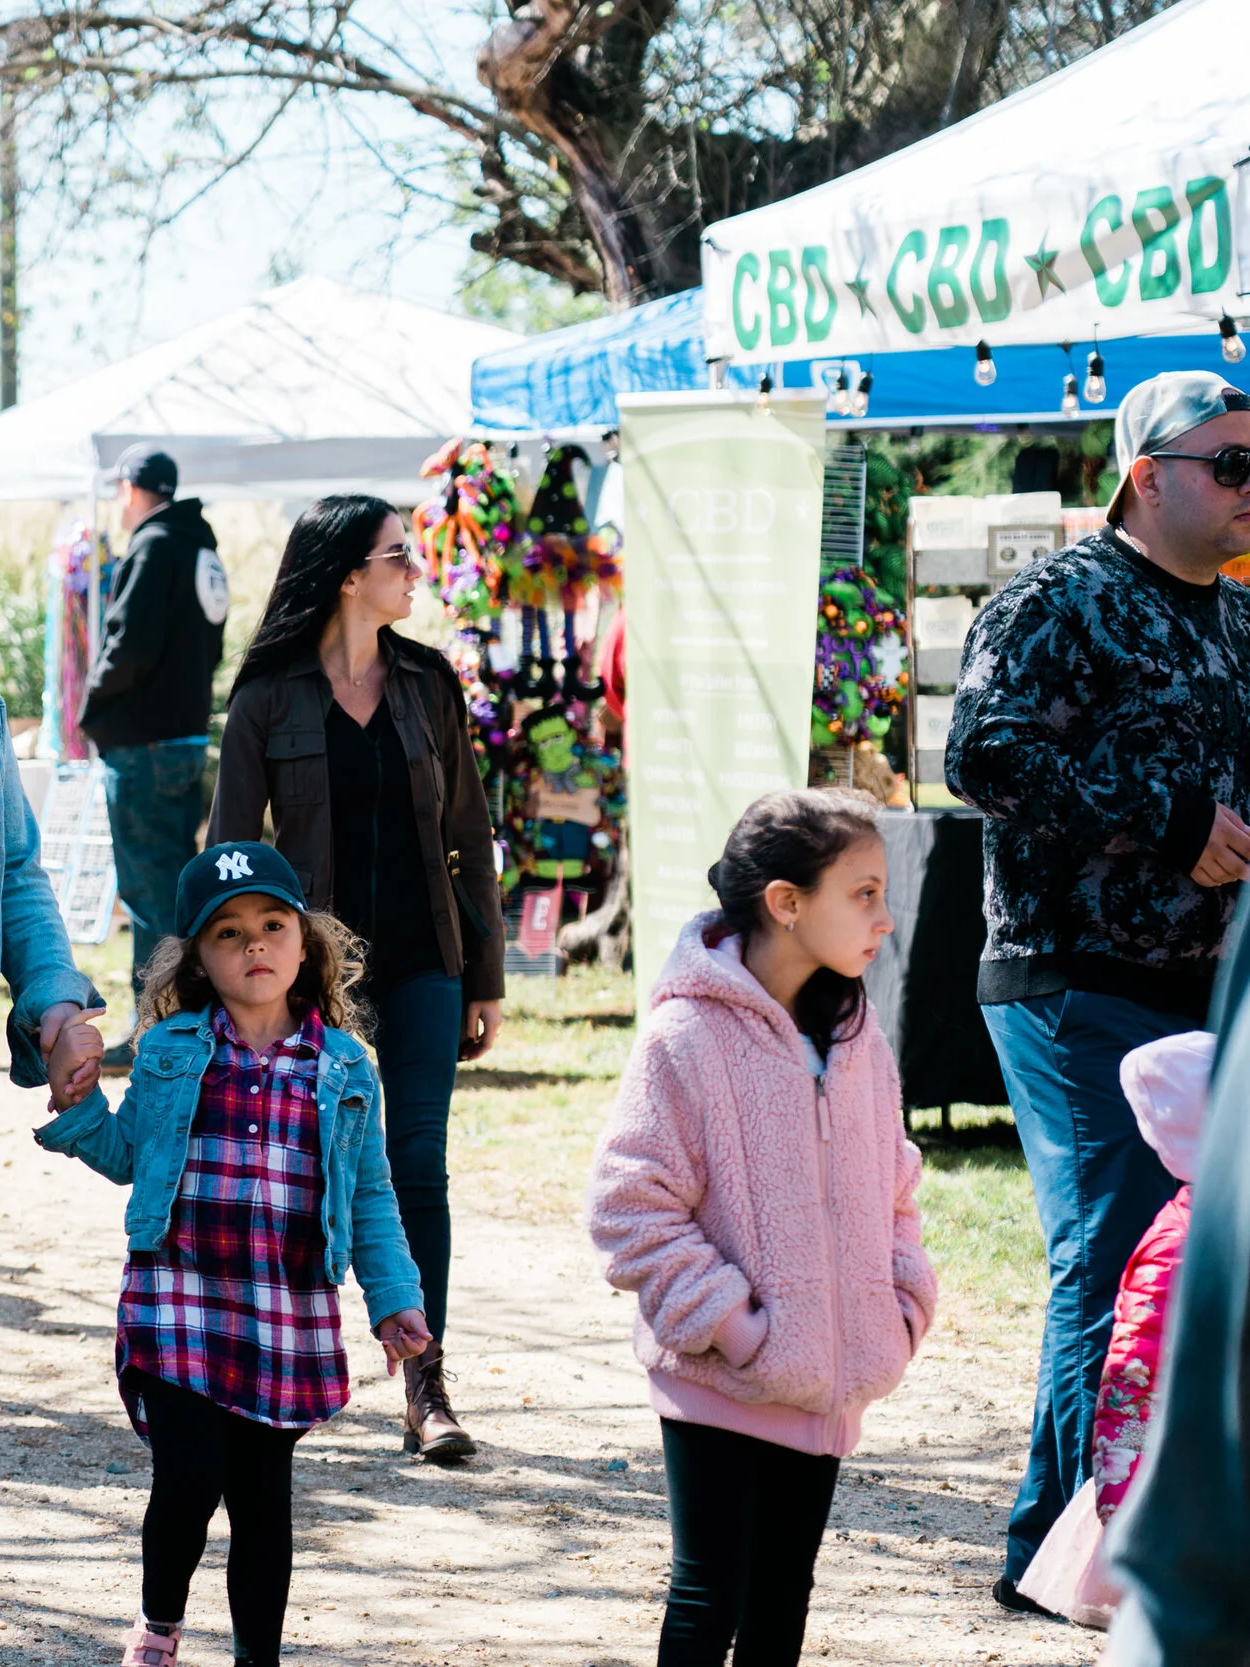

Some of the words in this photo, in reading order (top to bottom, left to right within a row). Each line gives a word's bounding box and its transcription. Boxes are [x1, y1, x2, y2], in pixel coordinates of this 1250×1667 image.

[732, 245, 839, 351] CBD
[887, 218, 1013, 334] CBD
[1080, 175, 1232, 307] CBD
[668, 485, 777, 534] CBD
[215, 850, 254, 881] NY
